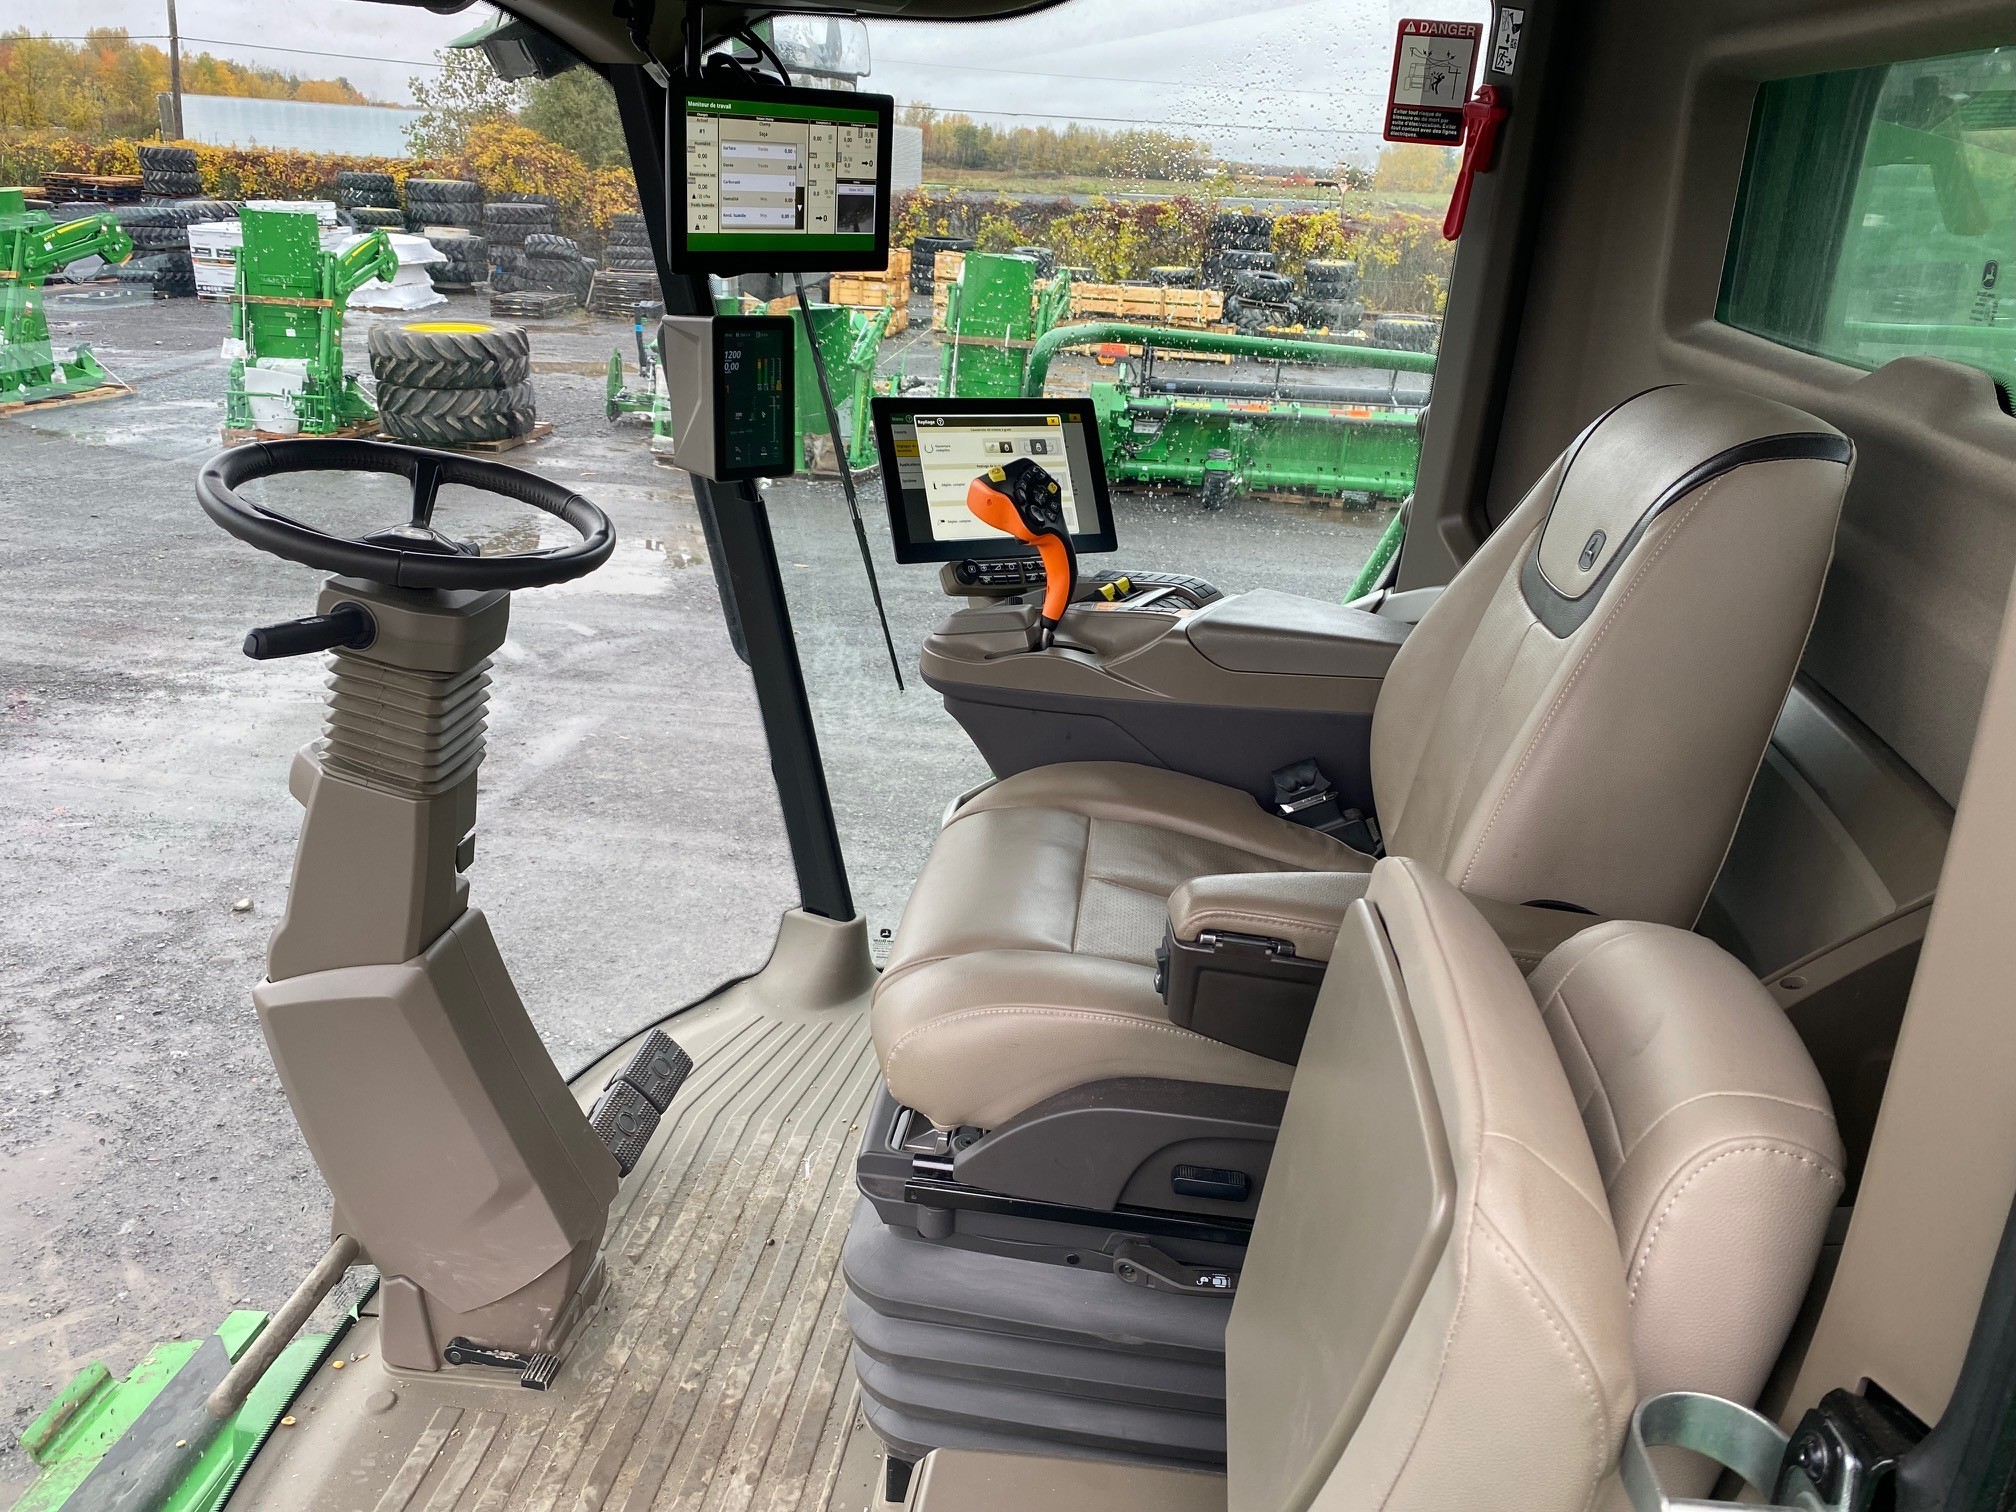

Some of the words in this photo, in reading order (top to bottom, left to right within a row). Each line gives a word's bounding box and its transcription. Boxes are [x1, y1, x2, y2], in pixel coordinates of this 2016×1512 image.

[1420, 22, 1476, 37] DANGER
[724, 351, 741, 359] 1200
[724, 363, 739, 371] 0,00
